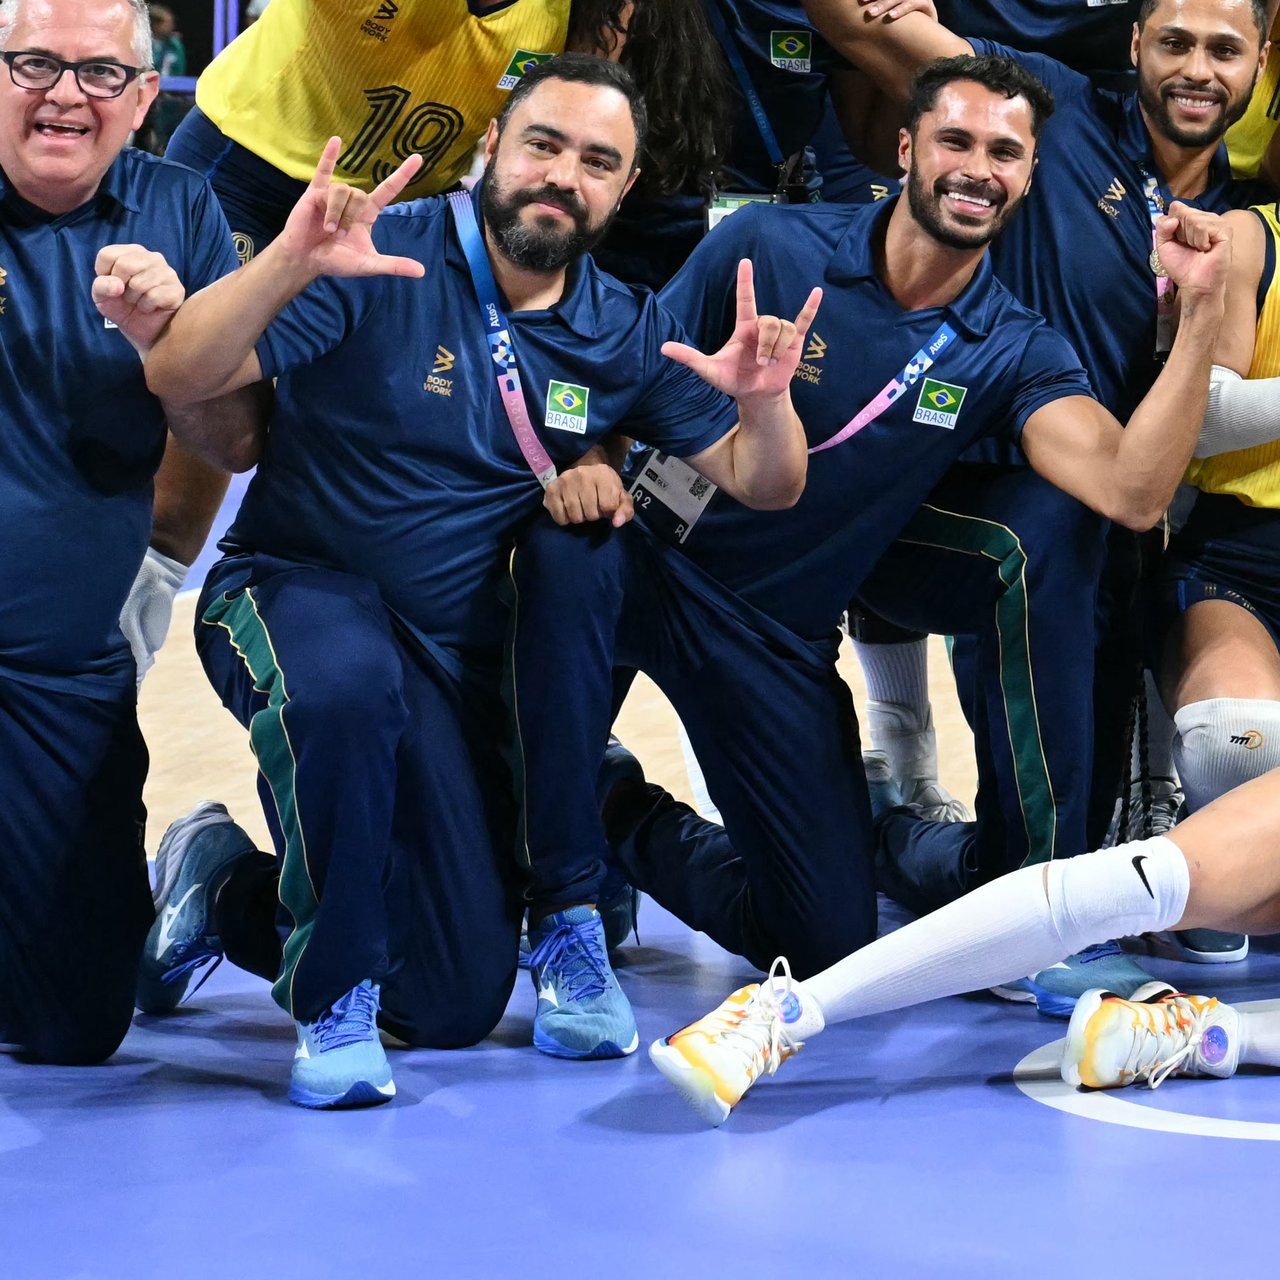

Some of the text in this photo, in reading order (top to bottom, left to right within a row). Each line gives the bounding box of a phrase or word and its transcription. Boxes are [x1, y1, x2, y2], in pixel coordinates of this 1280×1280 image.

[360, 24, 388, 43] WORK
[365, 19, 391, 35] BODY
[336, 85, 464, 187] 19
[486, 302, 500, 328] Atos
[929, 334, 948, 356] Atos
[794, 369, 821, 385] WORK
[798, 361, 824, 377] BODY
[423, 383, 453, 397] WORK
[427, 375, 453, 388] BODY
[546, 411, 585, 431] BRASIL
[914, 408, 954, 428] BRASIL
[642, 497, 652, 509] 2
